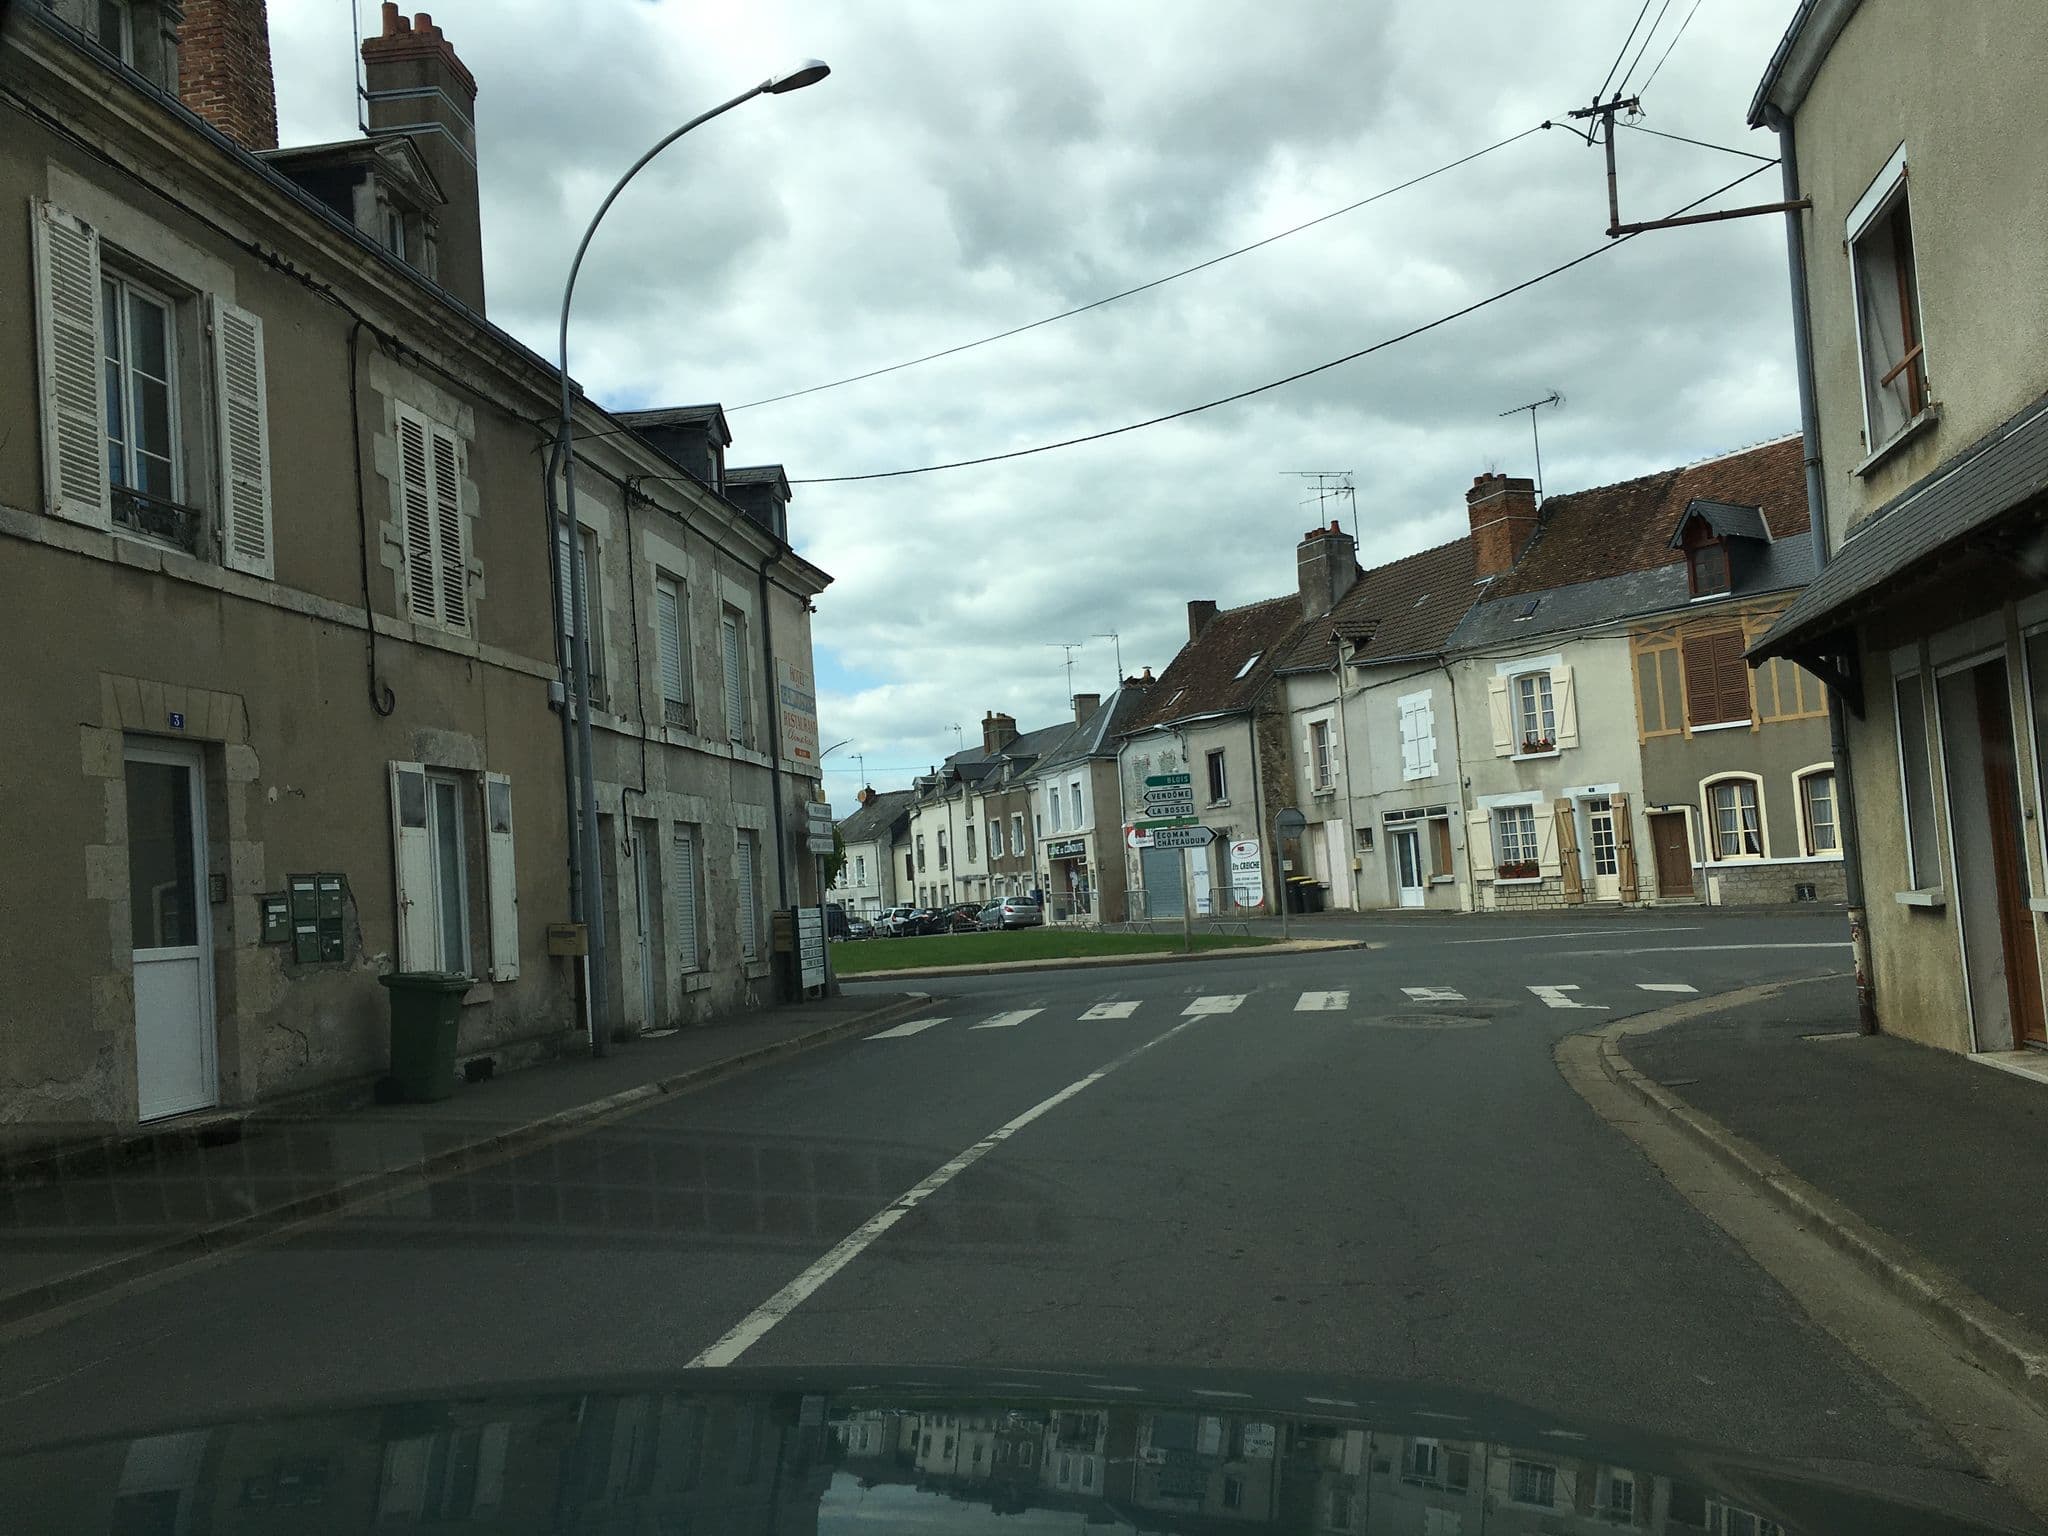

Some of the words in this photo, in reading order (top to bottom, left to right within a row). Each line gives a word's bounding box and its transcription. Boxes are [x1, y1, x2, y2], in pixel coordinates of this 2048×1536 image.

[174, 714, 180, 727] 3
[783, 711, 817, 735] RESTAURANT
[1166, 775, 1189, 784] BLOIS
[1151, 790, 1190, 800] VENDÔME
[1152, 807, 1162, 815] LA
[1164, 805, 1191, 814] BOSSE
[1157, 830, 1190, 840] ÉCOMAN
[1157, 837, 1206, 847] CHÂTEAUDUN
